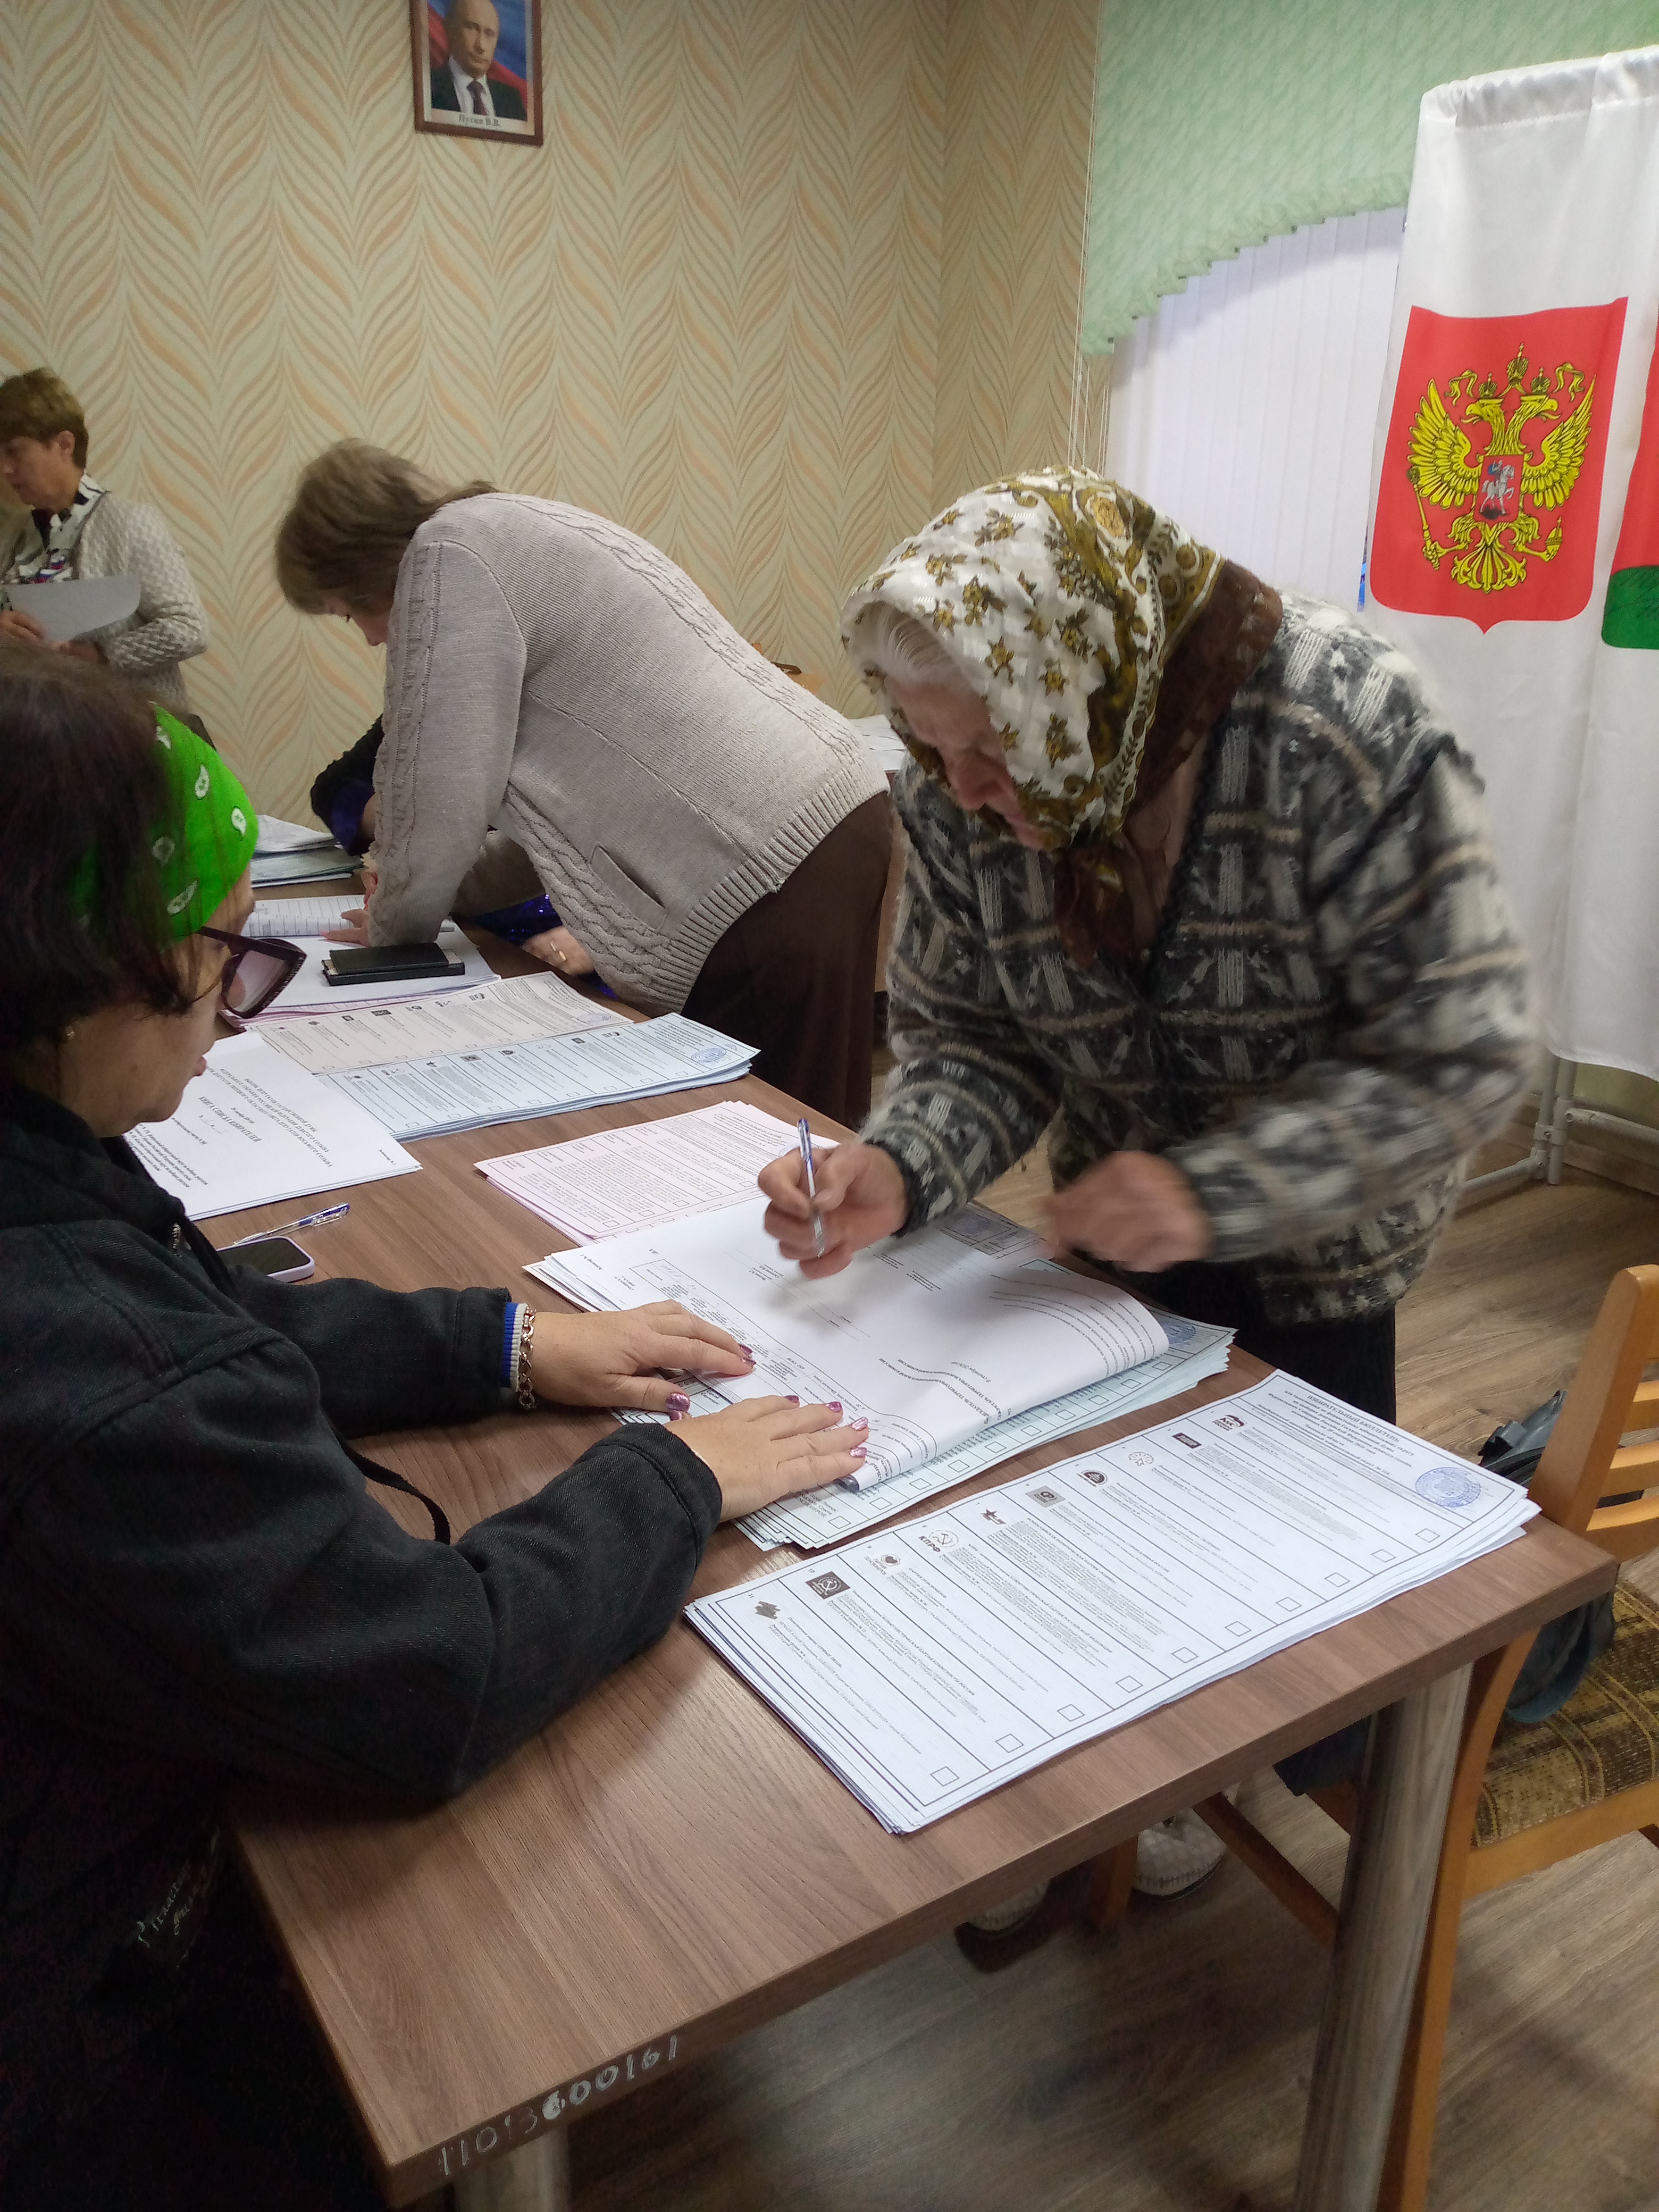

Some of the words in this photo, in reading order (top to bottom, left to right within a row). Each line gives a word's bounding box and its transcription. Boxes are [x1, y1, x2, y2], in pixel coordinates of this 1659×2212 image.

[1307, 1395, 1360, 1423] ИЗБИРАТЕЛЬНЫЙ
[1359, 1421, 1399, 1442] БЮЛЛЕТЕНЬ
[918, 1536, 941, 1552] КПРФ
